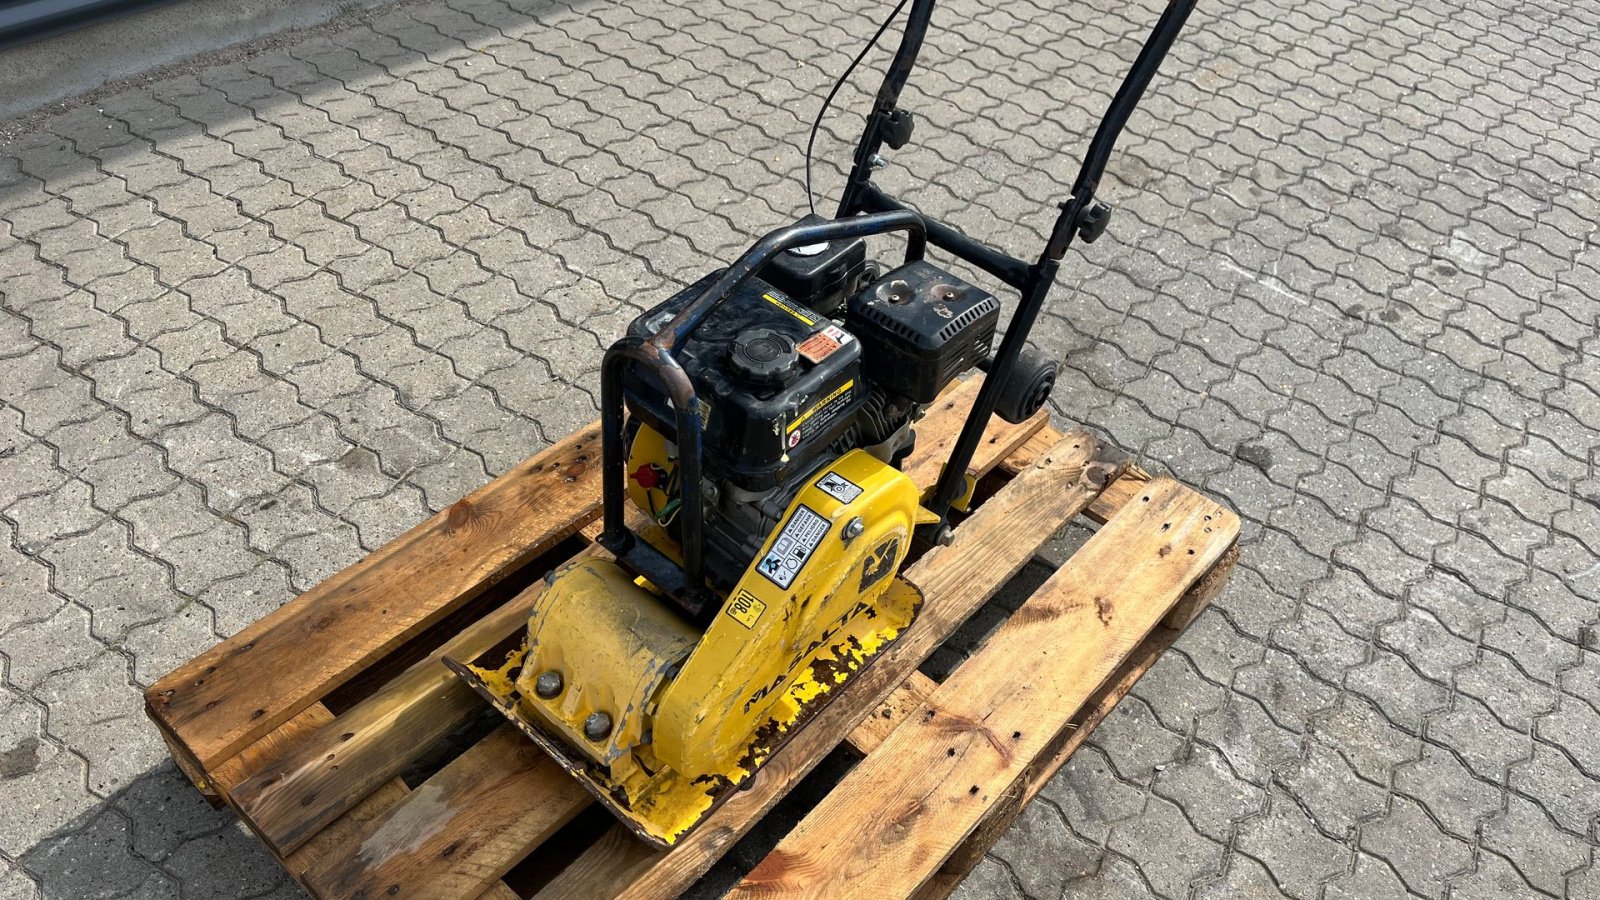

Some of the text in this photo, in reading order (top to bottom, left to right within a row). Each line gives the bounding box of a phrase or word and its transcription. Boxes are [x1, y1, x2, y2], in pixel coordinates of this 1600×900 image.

[791, 510, 806, 528] DANGER
[805, 519, 820, 538] PELIGRO
[812, 523, 827, 542] DANGER
[734, 593, 754, 614] 108
[744, 602, 868, 713] MASALTA
